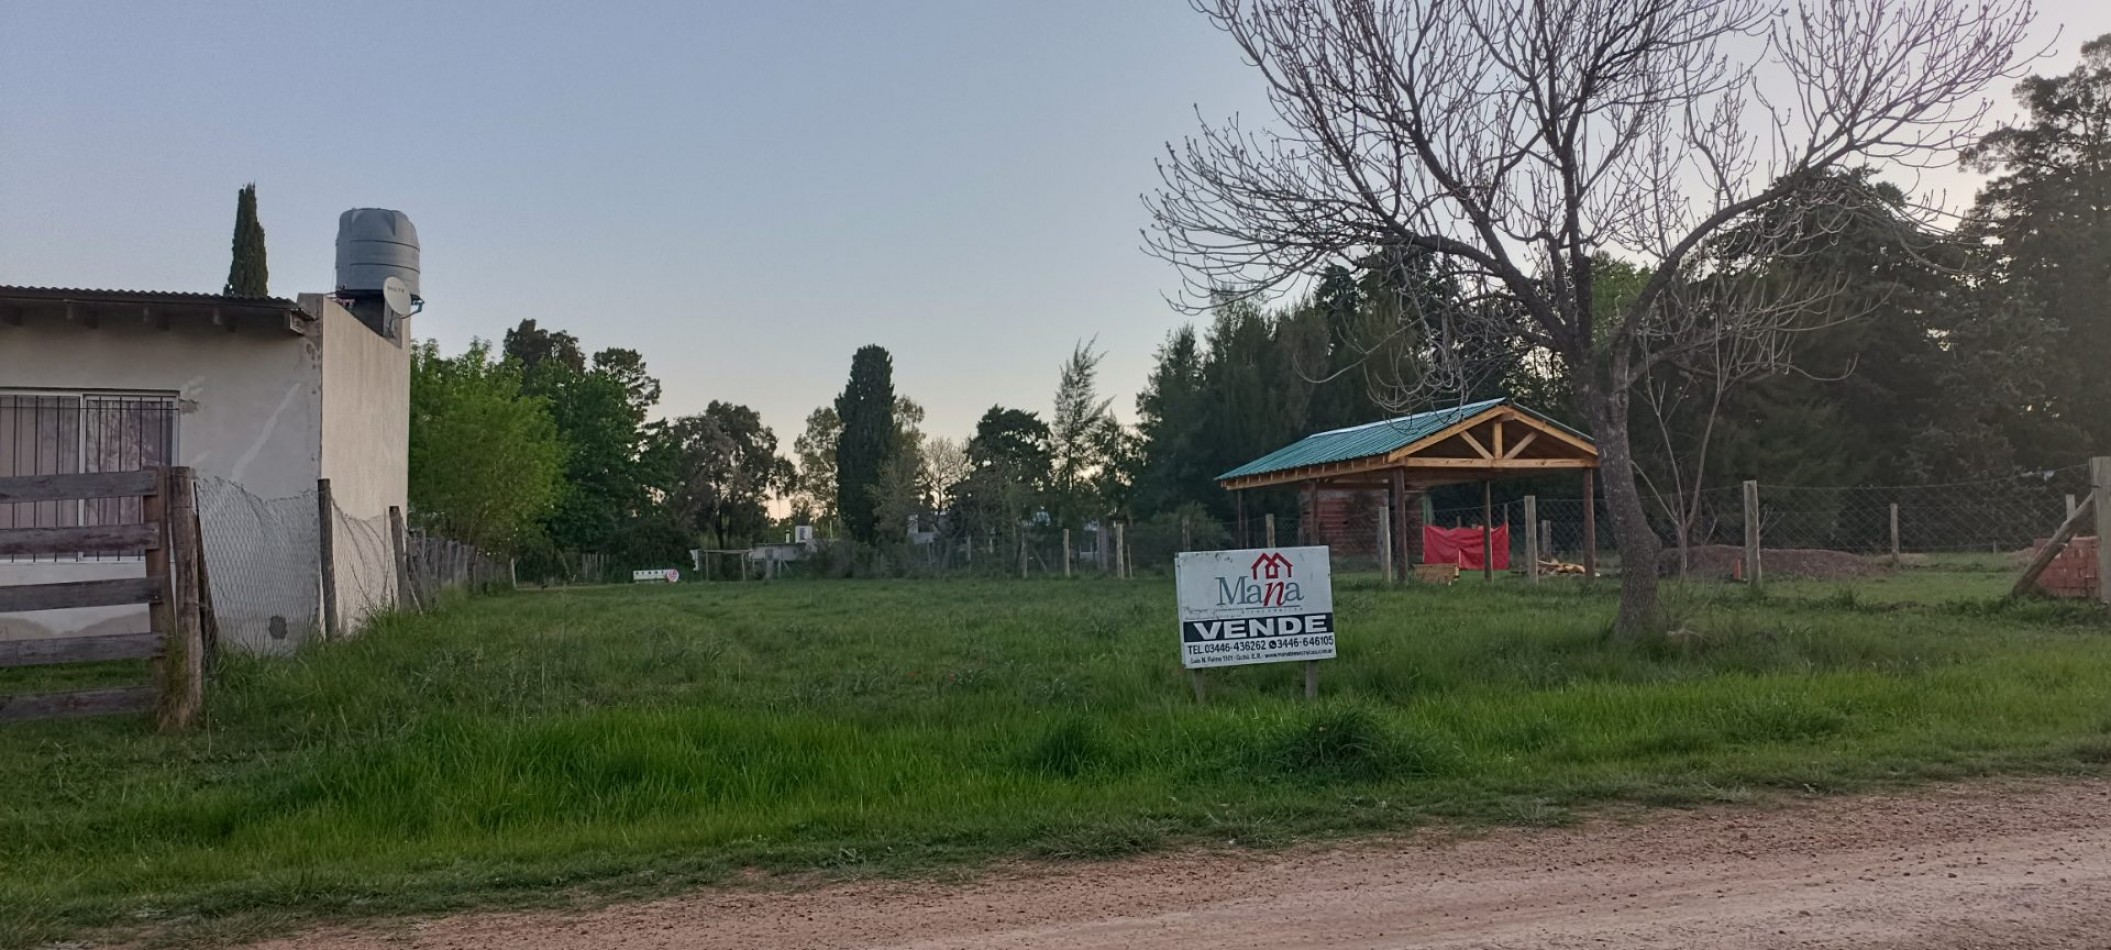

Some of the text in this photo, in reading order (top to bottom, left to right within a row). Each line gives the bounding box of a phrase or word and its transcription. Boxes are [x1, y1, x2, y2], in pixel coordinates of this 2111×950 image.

[1215, 576, 1304, 606] Mana
[1194, 615, 1327, 640] VENDE
[1277, 635, 1334, 649] 3446-646105
